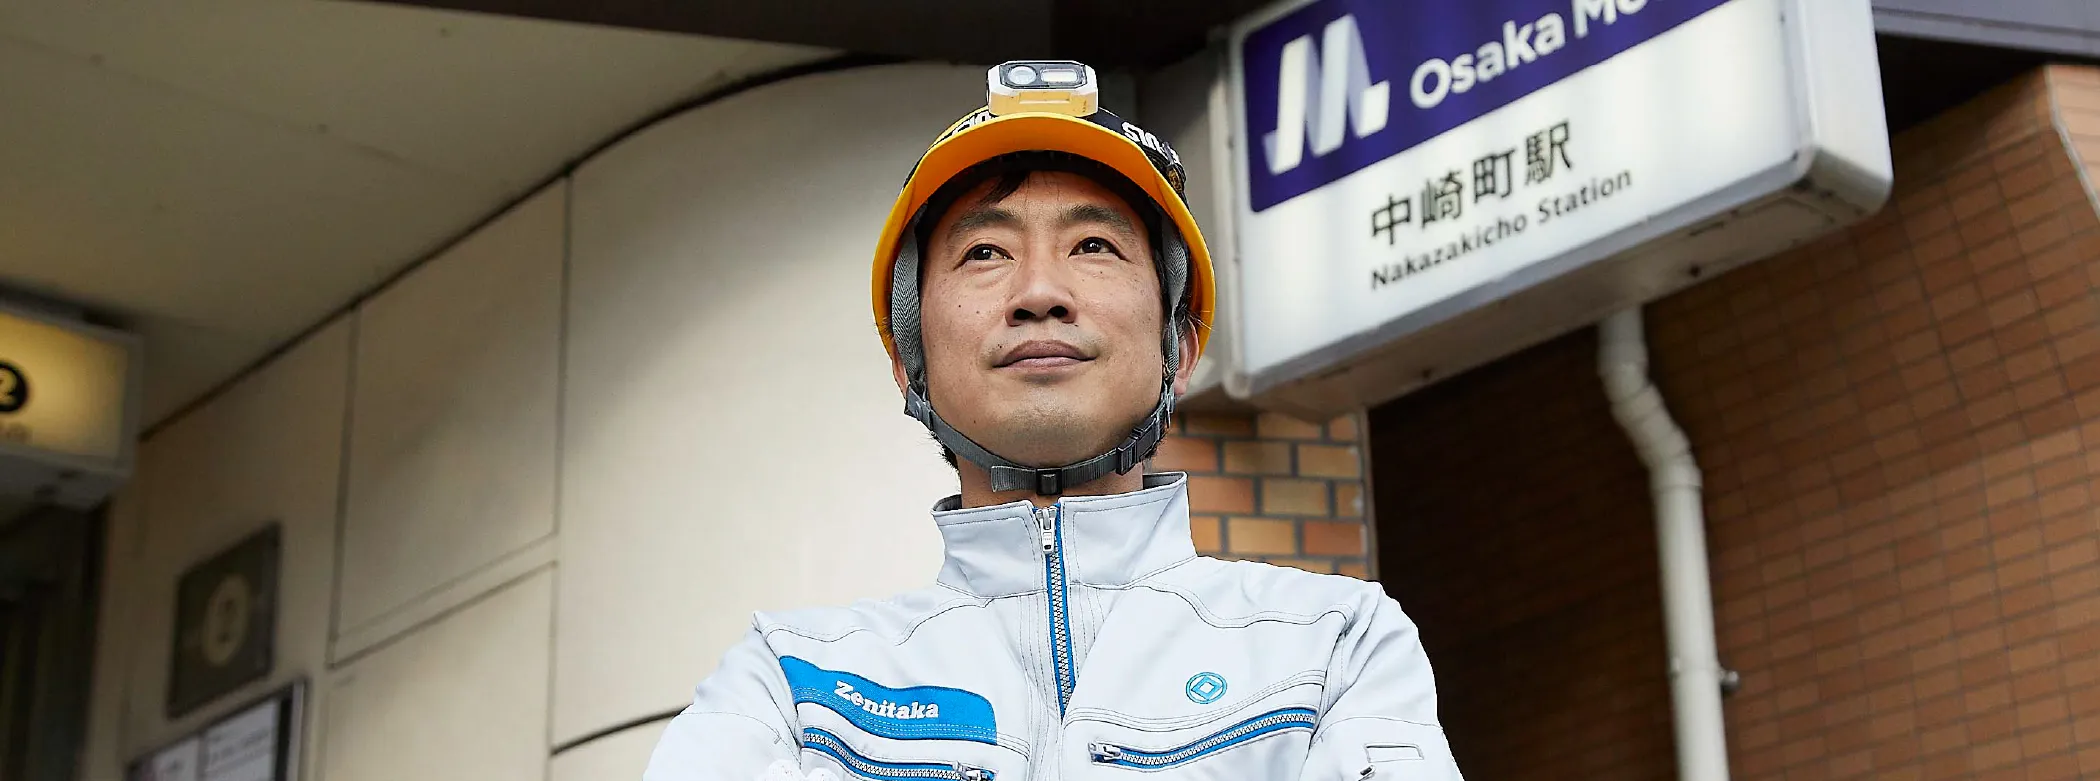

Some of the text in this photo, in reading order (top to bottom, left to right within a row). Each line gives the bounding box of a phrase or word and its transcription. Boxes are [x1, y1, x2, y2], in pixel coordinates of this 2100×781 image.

[1410, 12, 1566, 109] Osaka
[1371, 119, 1571, 245] 中崎町駅
[1371, 169, 1632, 290] Nakazakicho Station
[833, 680, 939, 719] Zenitaka
